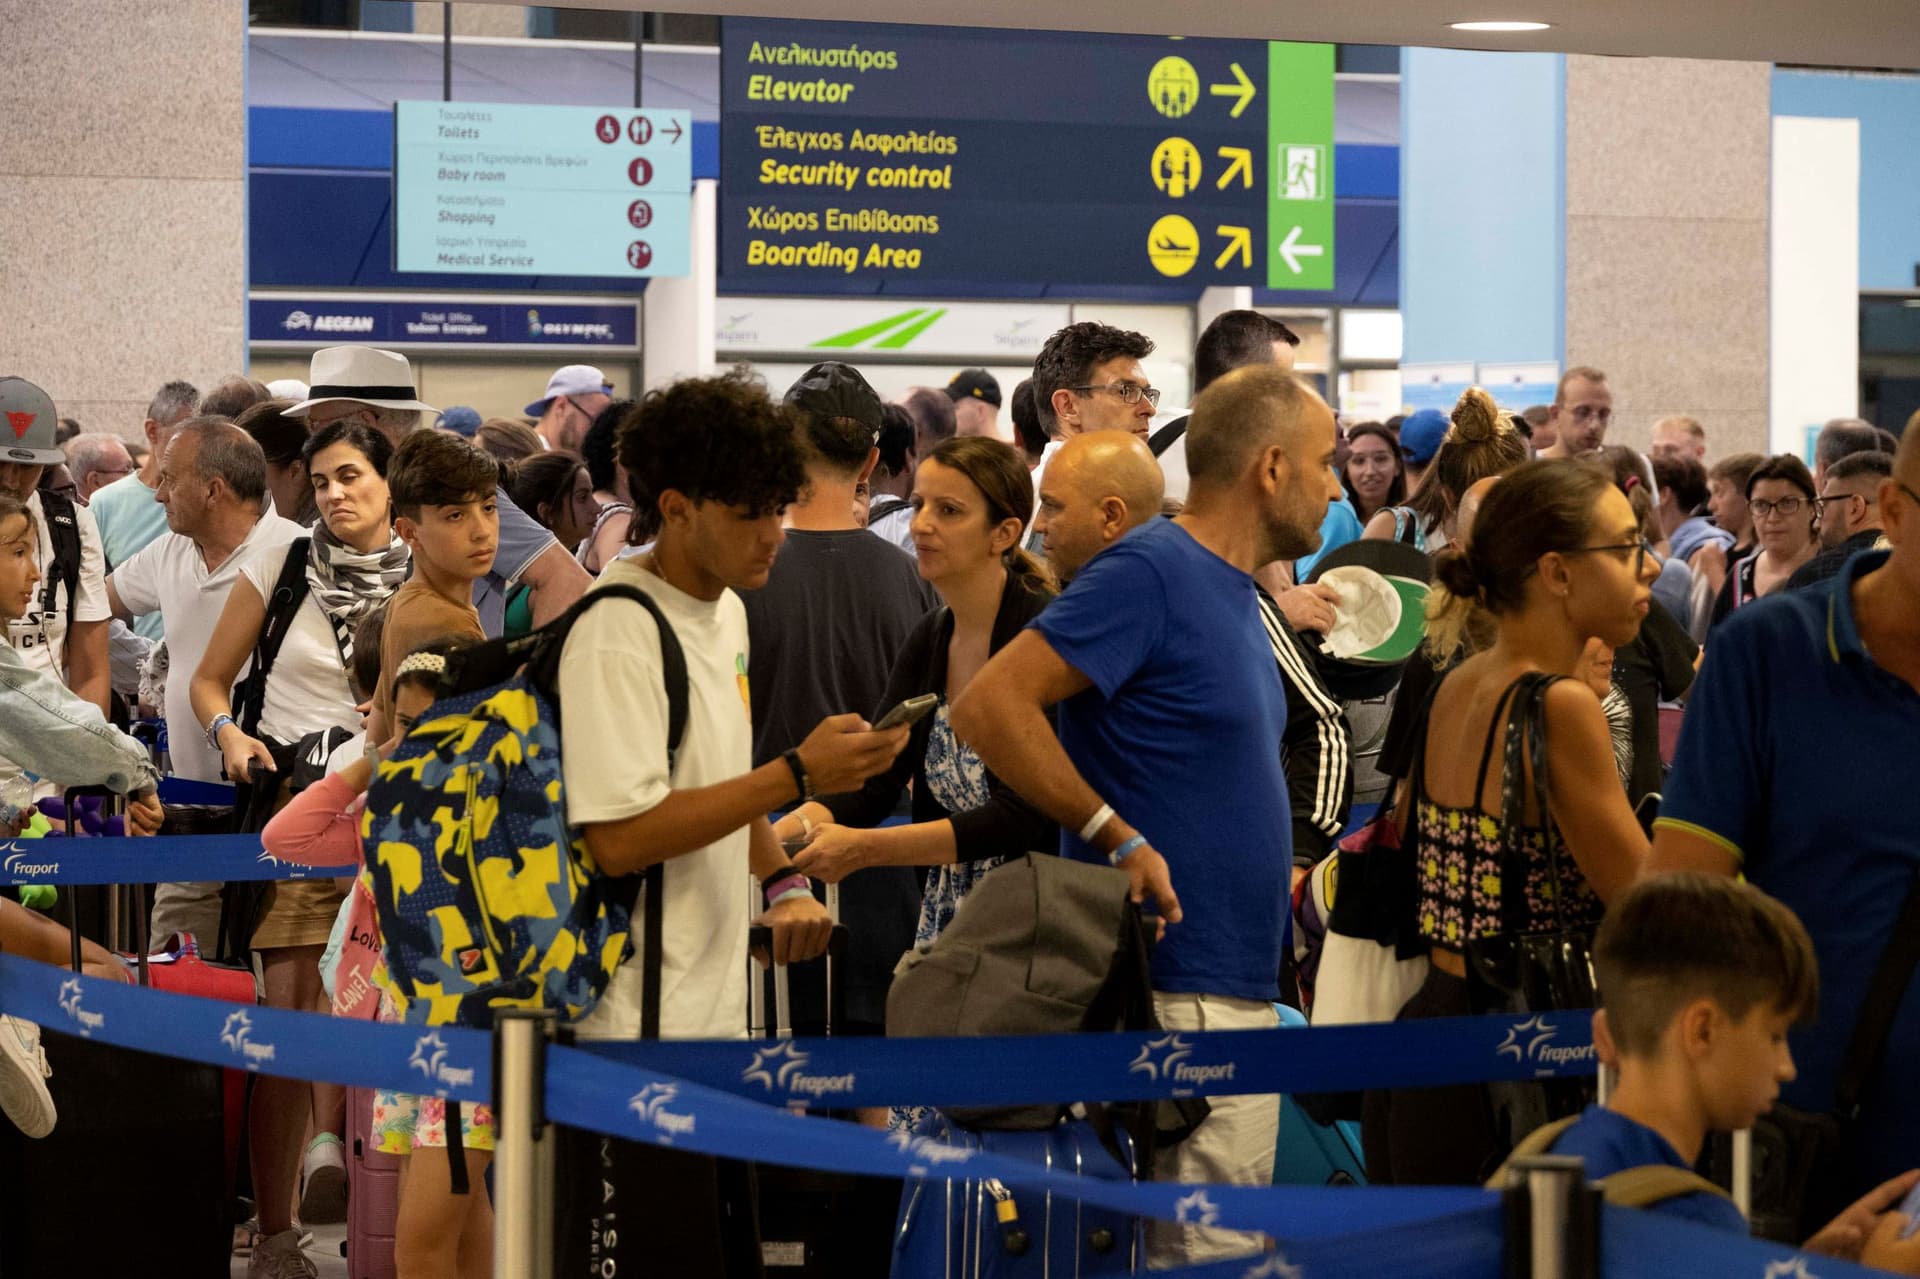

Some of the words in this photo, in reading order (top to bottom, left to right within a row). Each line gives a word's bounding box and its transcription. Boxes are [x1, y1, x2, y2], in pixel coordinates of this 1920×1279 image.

[748, 41, 898, 73] Ανελκυστήρας
[748, 74, 855, 103] Elevator
[437, 125, 480, 139] Toilets
[755, 125, 844, 154] Έλεγχος
[849, 128, 958, 157] Ασφαλείας
[437, 167, 470, 183] Baby
[473, 170, 506, 182] room
[759, 158, 860, 192] Security
[866, 164, 953, 190] control
[437, 209, 496, 226] Shopping
[747, 205, 819, 235] Χώρος
[825, 208, 940, 234] Επιβίβασης
[437, 252, 485, 266] Medical
[489, 253, 535, 267] Service
[747, 239, 859, 274] Boarding
[863, 242, 922, 269] Area
[313, 315, 374, 332] AEGEAN
[14, 861, 60, 878] Fraport
[1538, 1043, 1595, 1067] Fraport
[790, 1072, 856, 1098] Fraport
[1174, 1061, 1236, 1085] Fraport
[590, 1218, 600, 1274] PARIS
